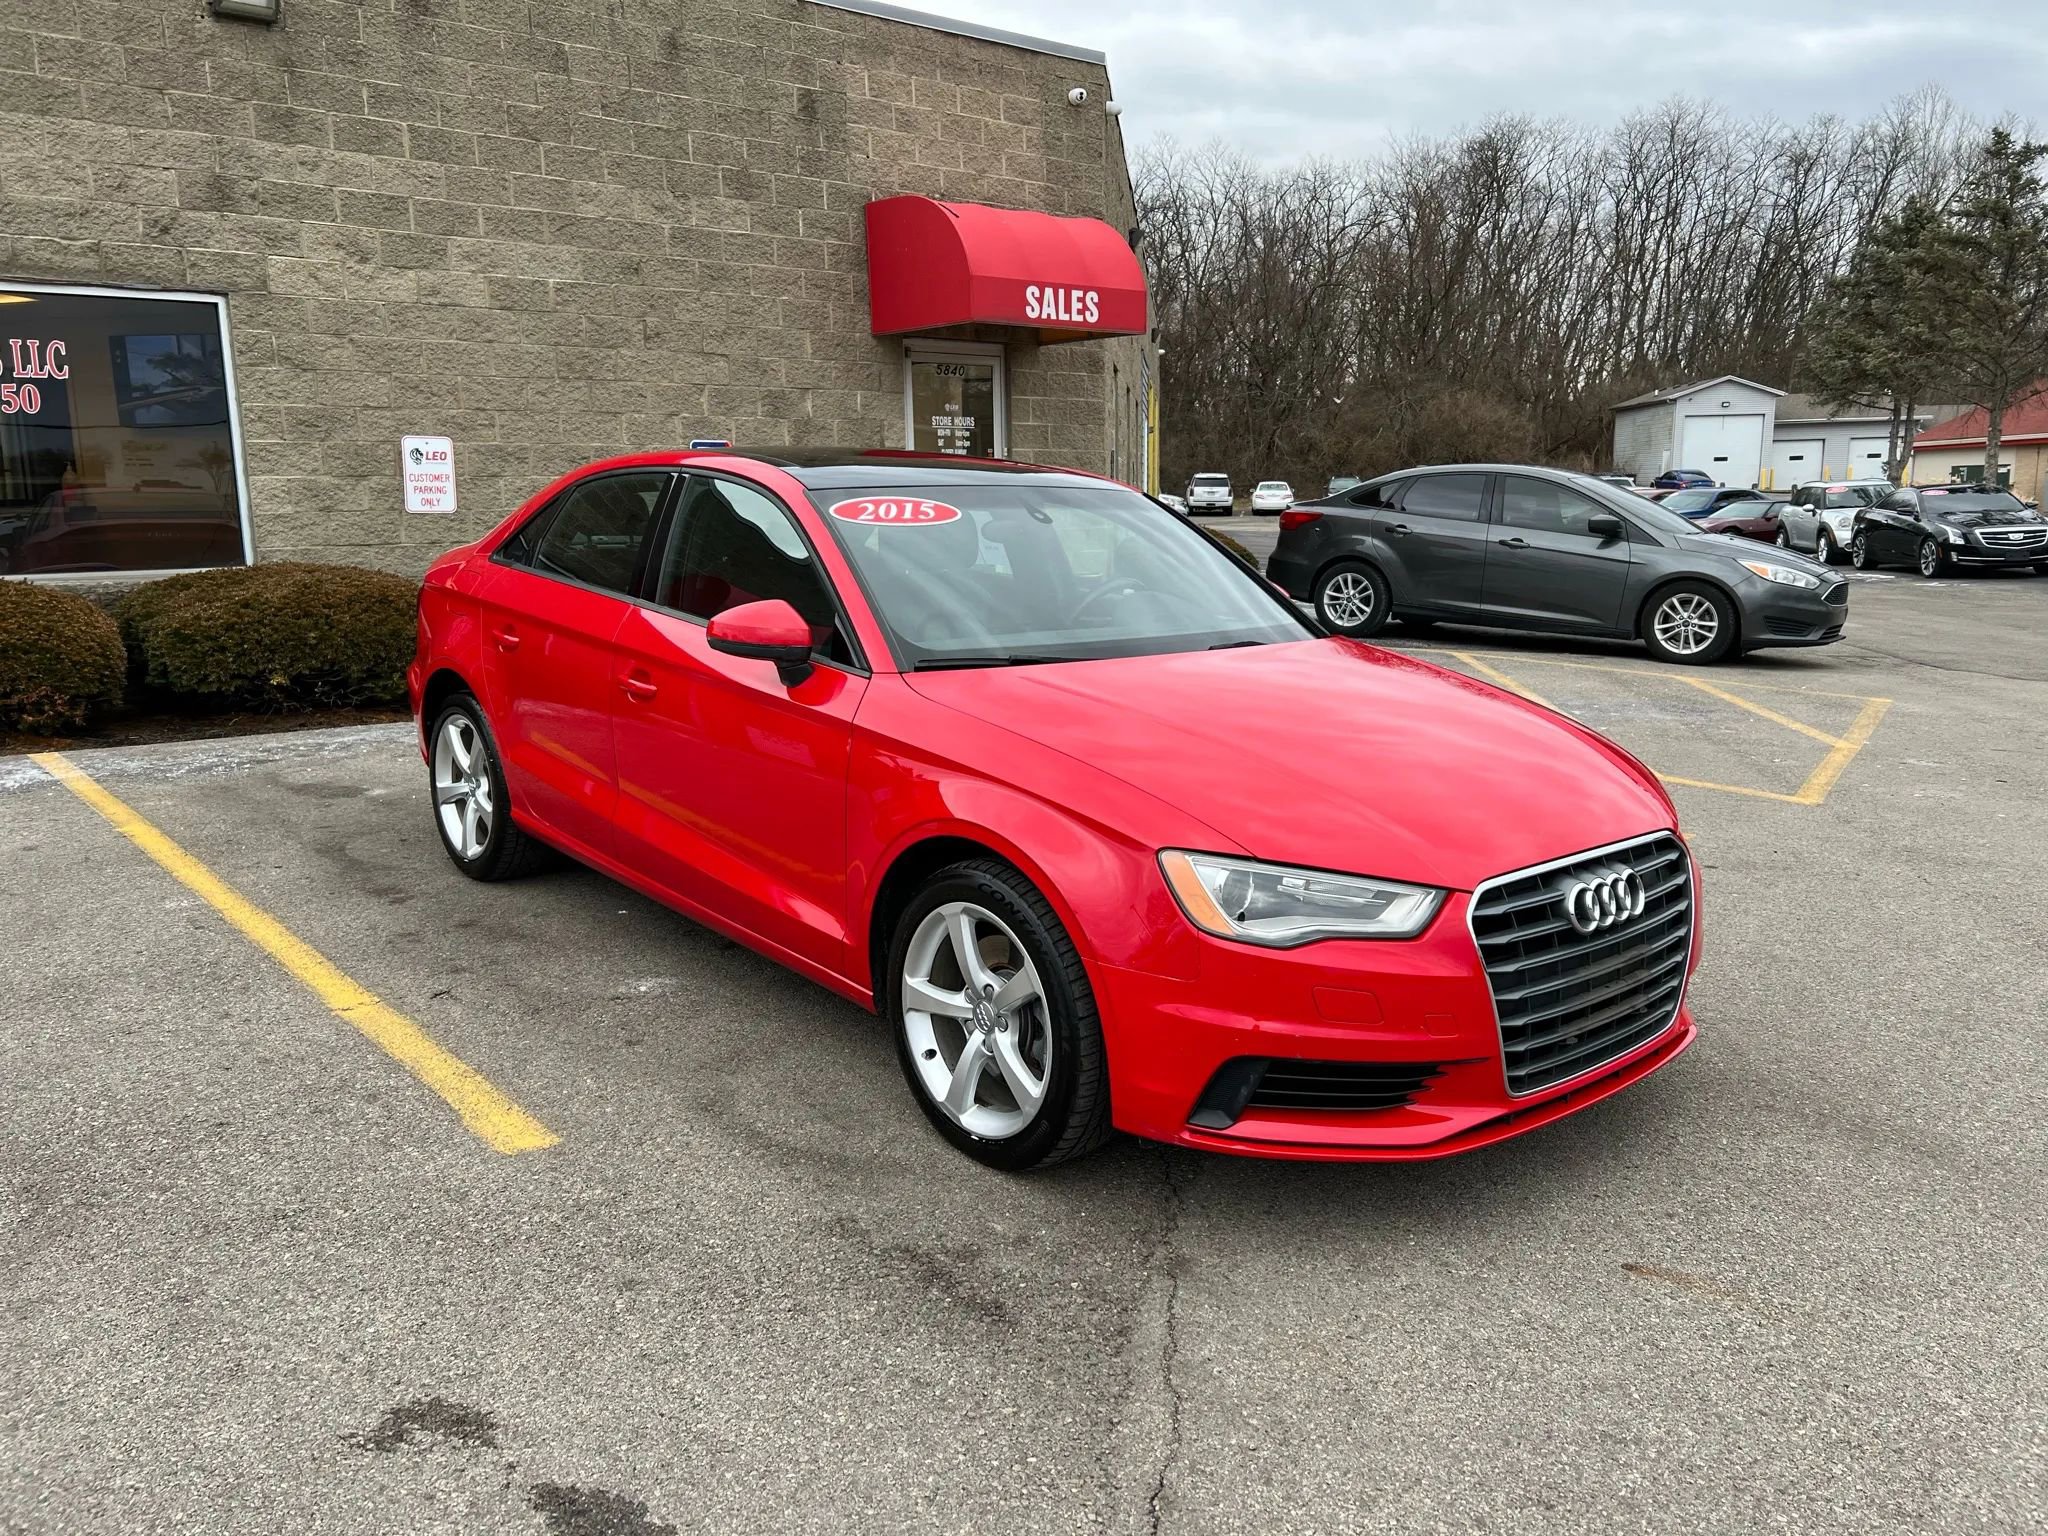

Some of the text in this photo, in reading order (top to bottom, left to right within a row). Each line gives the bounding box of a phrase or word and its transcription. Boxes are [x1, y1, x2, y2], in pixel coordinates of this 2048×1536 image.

[1025, 285, 1099, 324] SALES
[9, 338, 69, 379] LLC
[936, 365, 965, 376] 5840
[1, 383, 41, 414] 50
[931, 415, 976, 427] STORE HOURS
[425, 451, 448, 461] LEO
[408, 473, 450, 483] CUSTOMER
[413, 486, 447, 495] PARKING
[420, 498, 441, 507] ONLY
[857, 502, 936, 520] 2015
